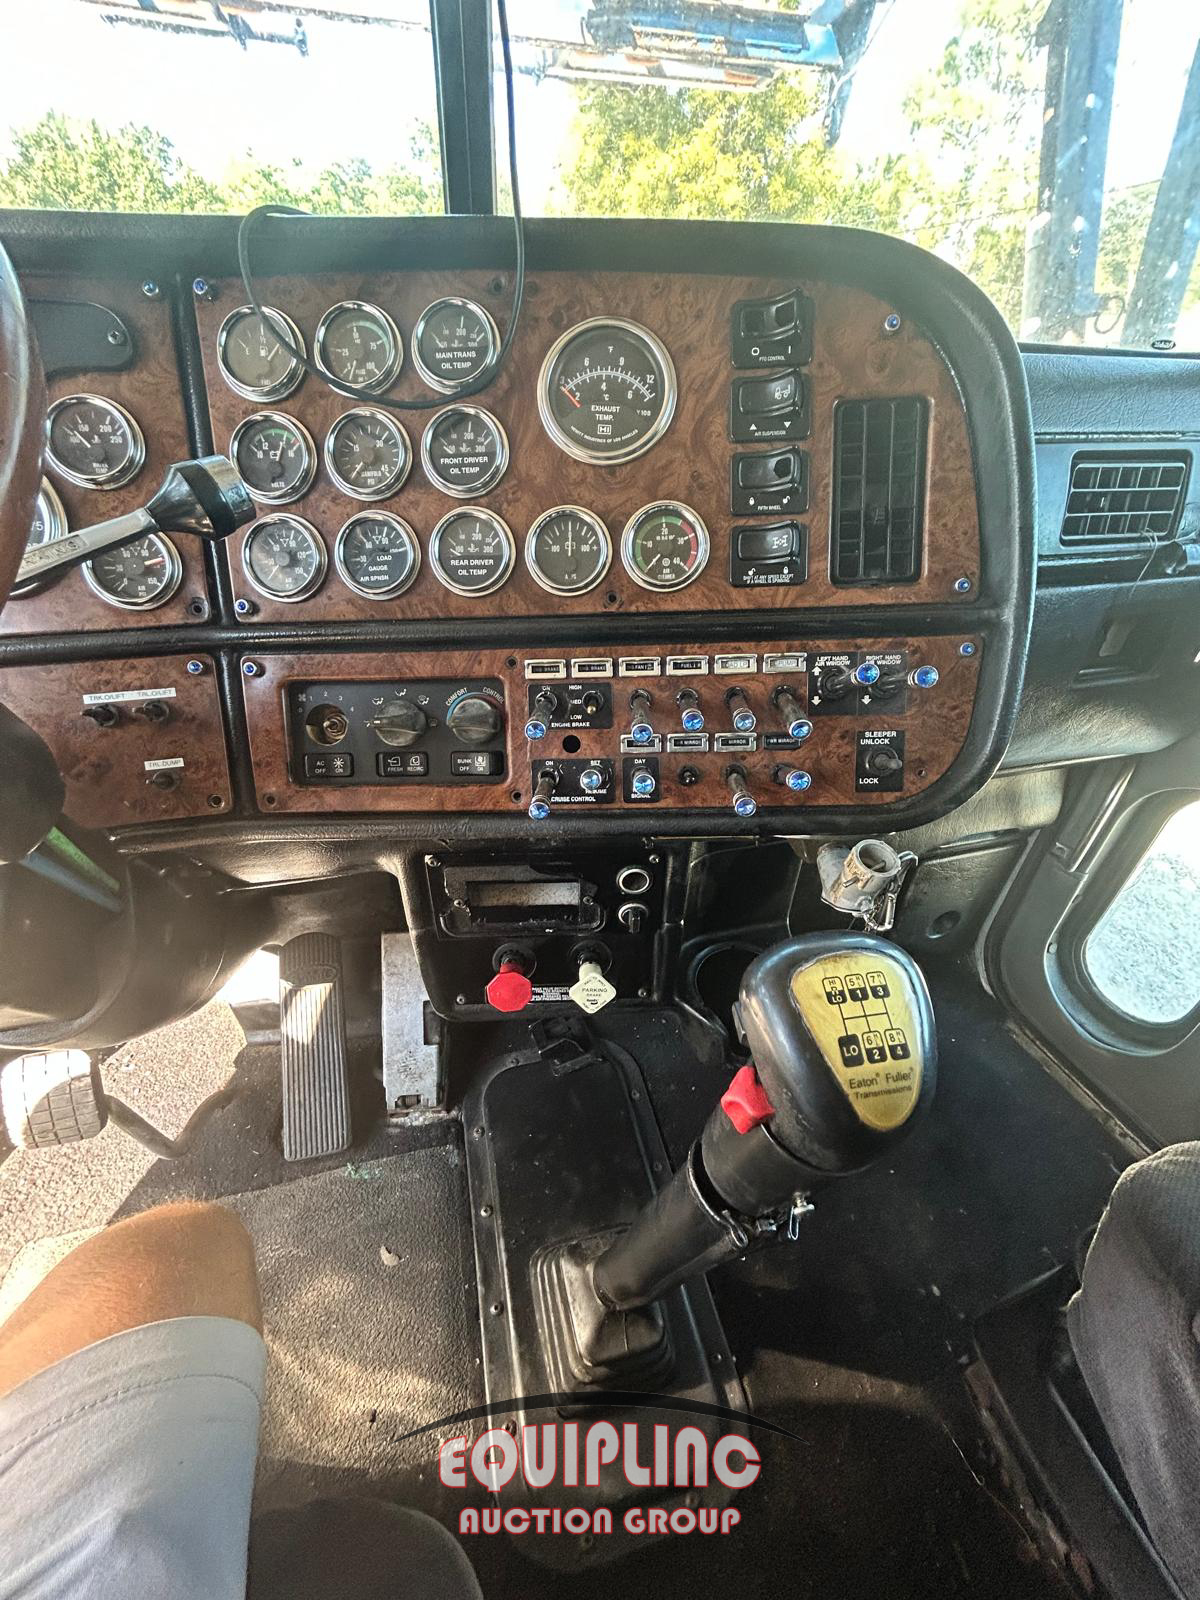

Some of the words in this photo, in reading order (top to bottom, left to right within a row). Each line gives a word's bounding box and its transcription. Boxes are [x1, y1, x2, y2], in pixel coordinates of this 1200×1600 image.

[456, 328, 466, 336] 200
[370, 342, 377, 350] 75
[342, 348, 350, 356] 25
[584, 357, 590, 366] 6
[619, 357, 625, 366] 9
[646, 374, 655, 383] 12
[601, 382, 607, 391] 4
[575, 392, 580, 400] 2
[628, 391, 633, 400] 6
[591, 405, 620, 413] EXHAUST
[463, 432, 474, 440] 200
[376, 440, 384, 448] 30
[475, 445, 486, 453] 300
[288, 450, 294, 458] 16
[463, 456, 488, 464] DRIVER
[381, 464, 389, 472] 45
[463, 466, 480, 474] TEMP
[551, 544, 560, 553] 100
[581, 544, 590, 552] 100
[673, 557, 681, 565] 40
[446, 688, 468, 706] COMFORT
[483, 687, 505, 705] CONTROL
[849, 978, 855, 986] 5
[871, 975, 876, 983] 7
[867, 1036, 873, 1045] 6
[889, 1034, 896, 1042] 8
[844, 1046, 858, 1057] LO
[874, 1051, 880, 1059] 2
[896, 1047, 903, 1056] 4
[855, 1085, 912, 1099] Transmissions
